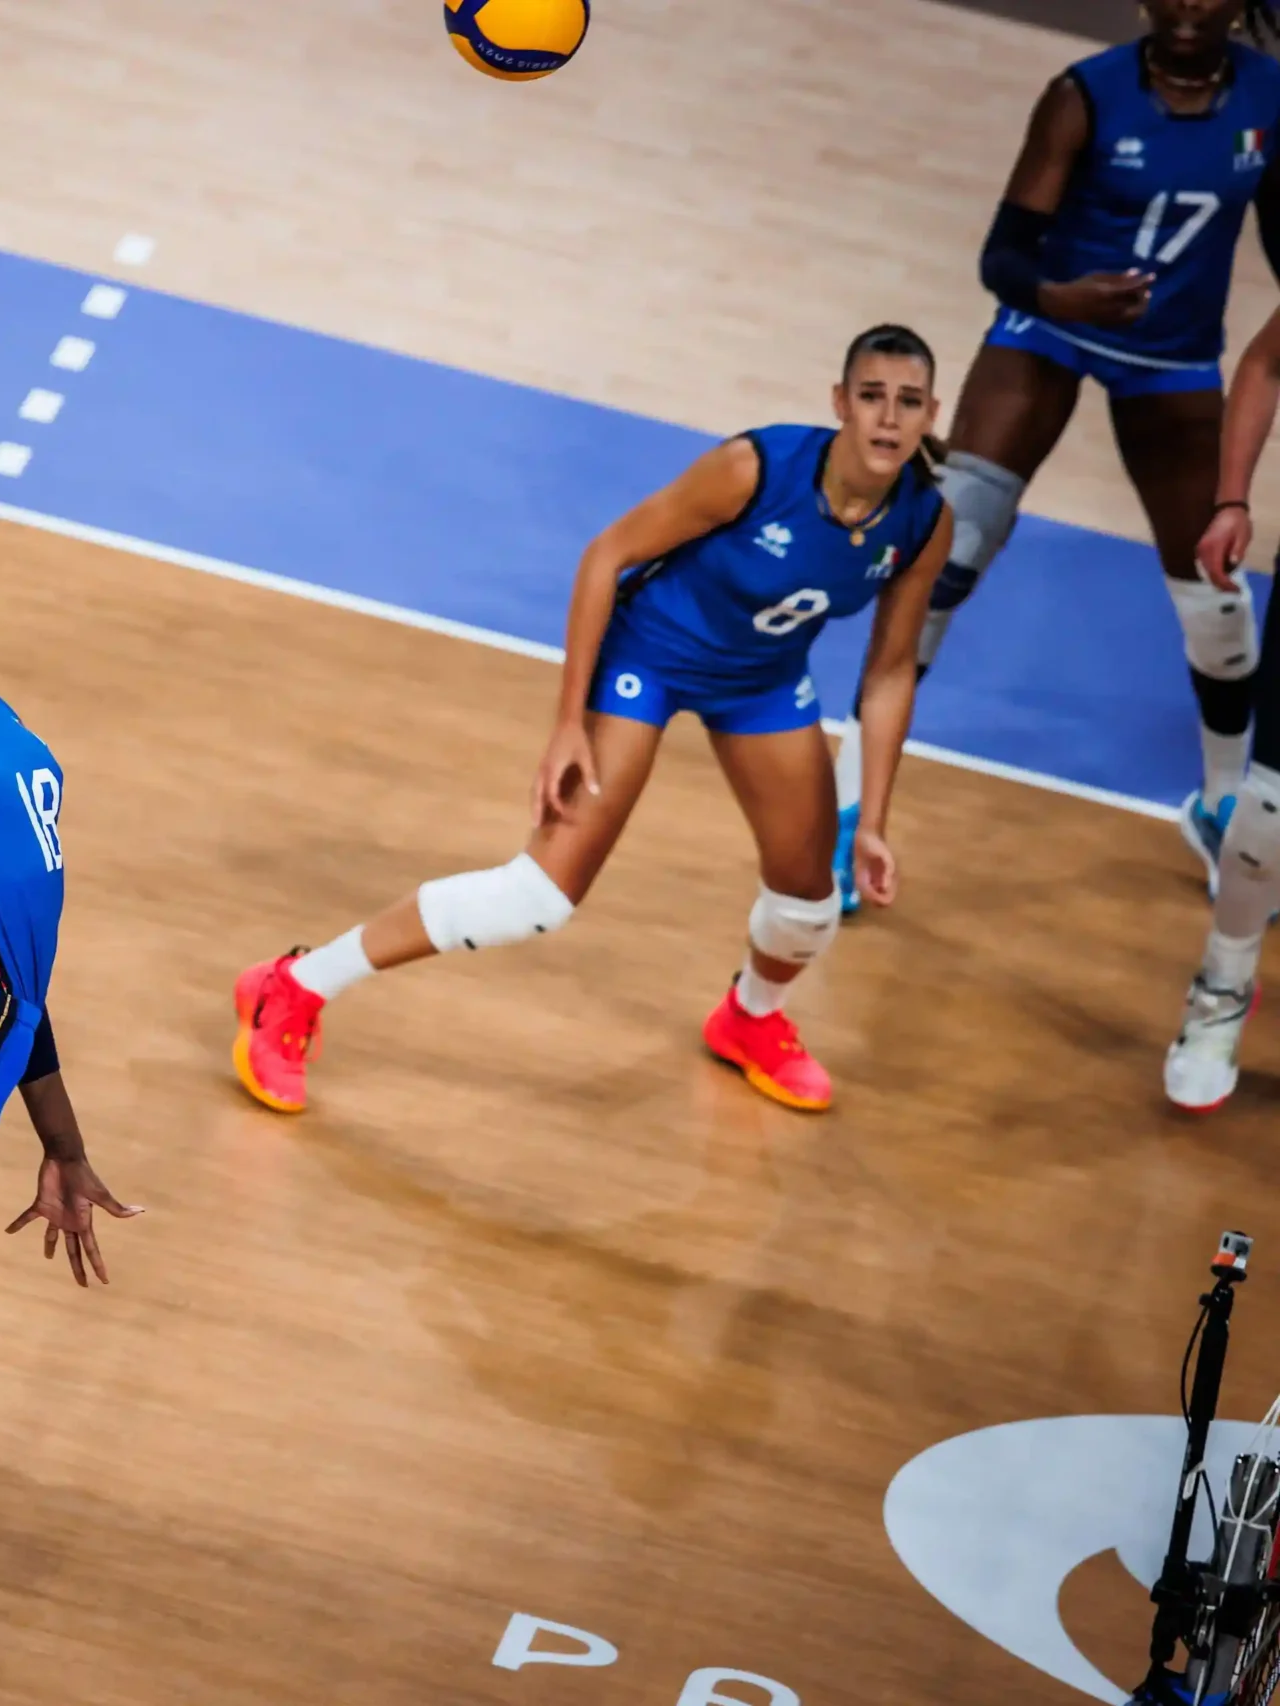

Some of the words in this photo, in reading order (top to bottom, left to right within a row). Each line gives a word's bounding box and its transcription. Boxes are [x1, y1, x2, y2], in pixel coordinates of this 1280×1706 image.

[1133, 190, 1220, 263] 17
[752, 588, 830, 636] 8
[16, 767, 63, 873] 18
